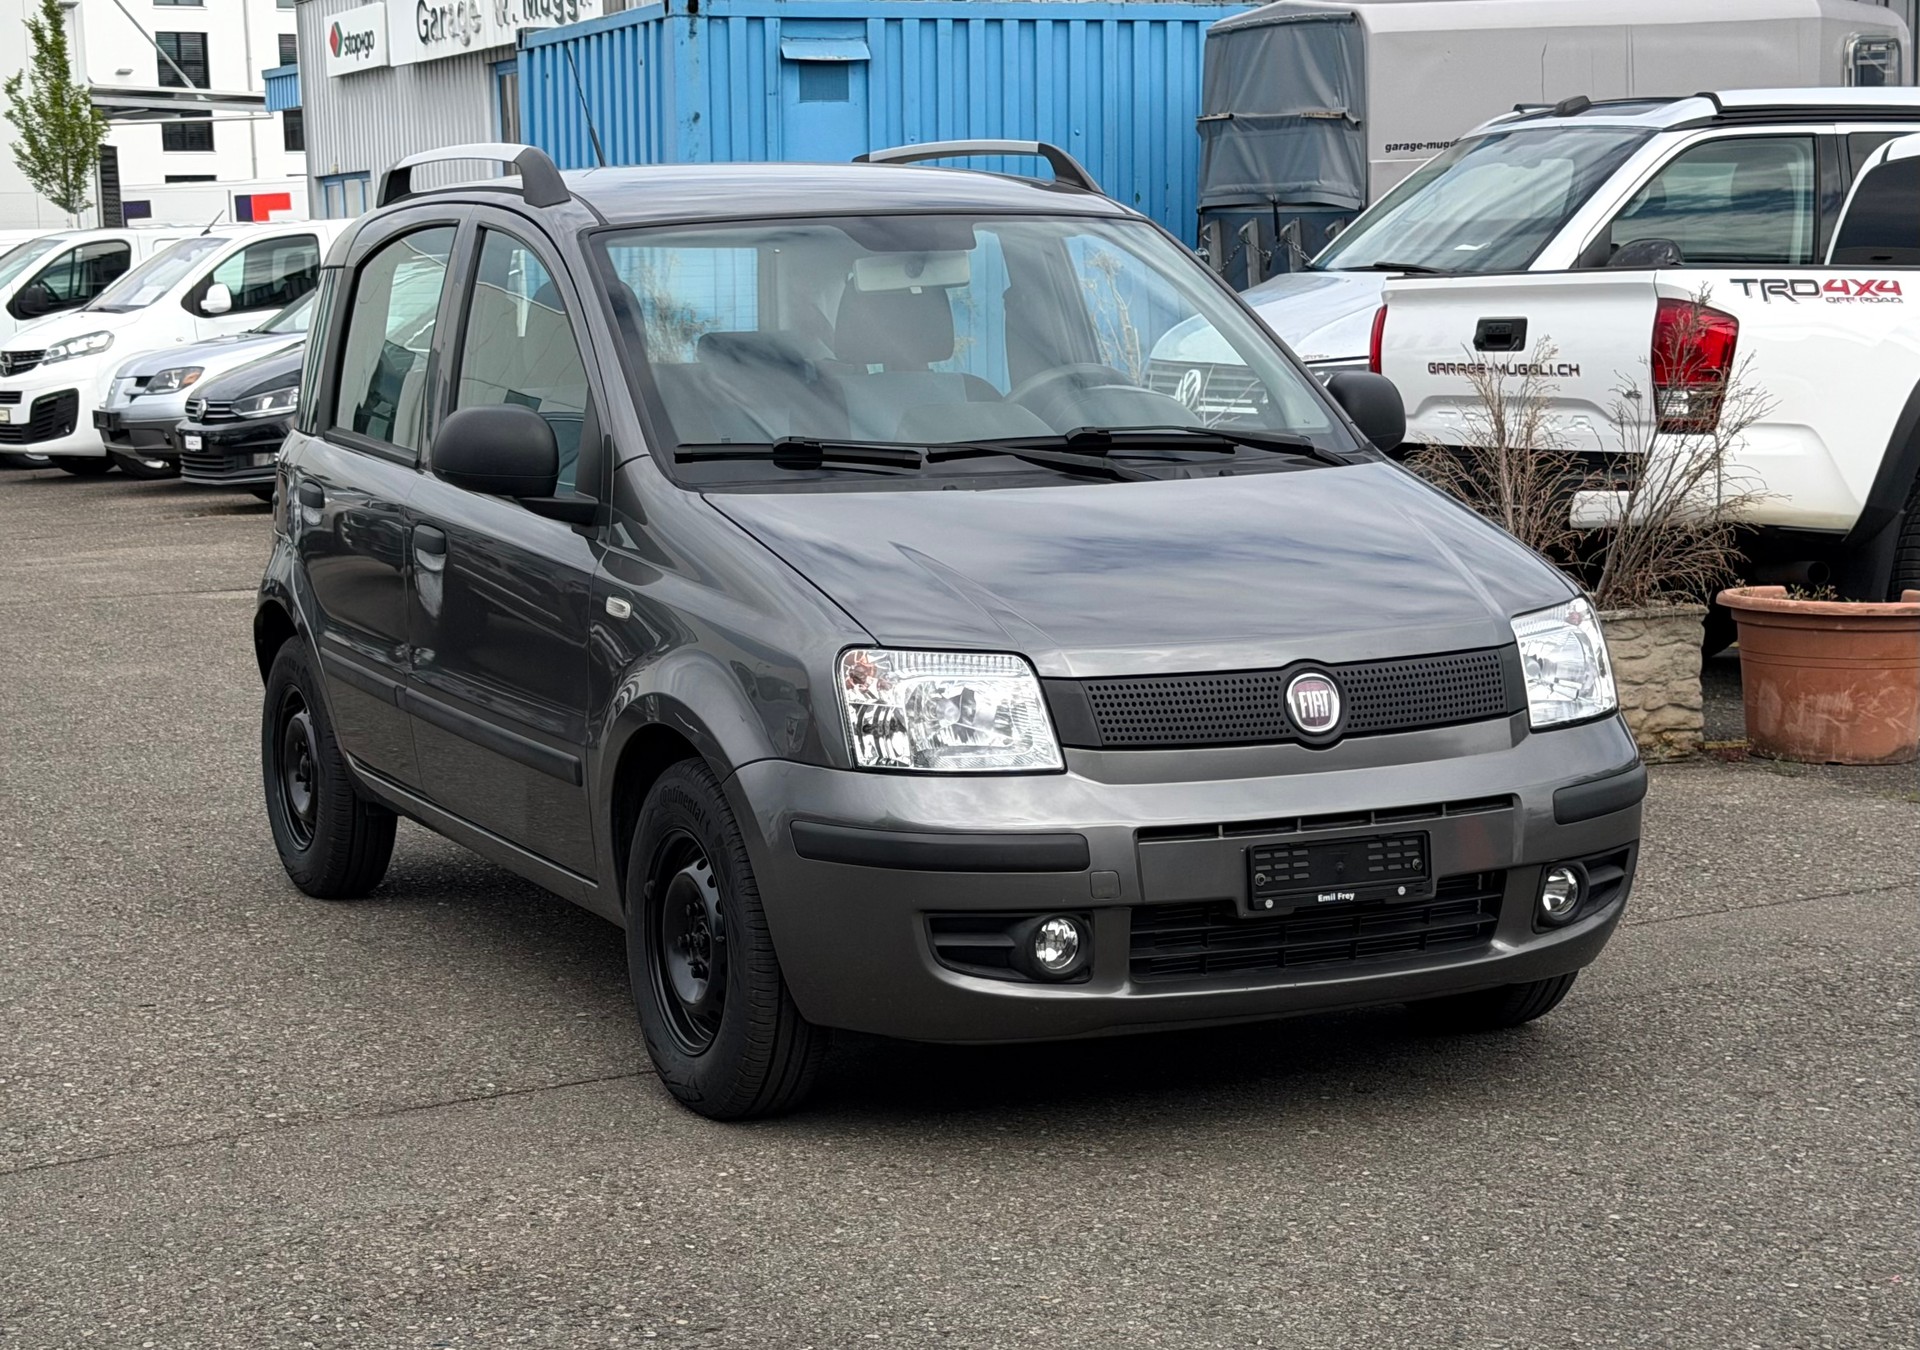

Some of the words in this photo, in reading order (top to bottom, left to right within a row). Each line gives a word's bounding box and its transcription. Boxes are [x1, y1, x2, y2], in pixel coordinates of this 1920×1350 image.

[416, 0, 481, 47] Garage
[1729, 278, 1821, 304] TRD
[1298, 689, 1329, 719] FIAT
[1317, 893, 1336, 903] Emil
[1337, 892, 1355, 901] Frey
